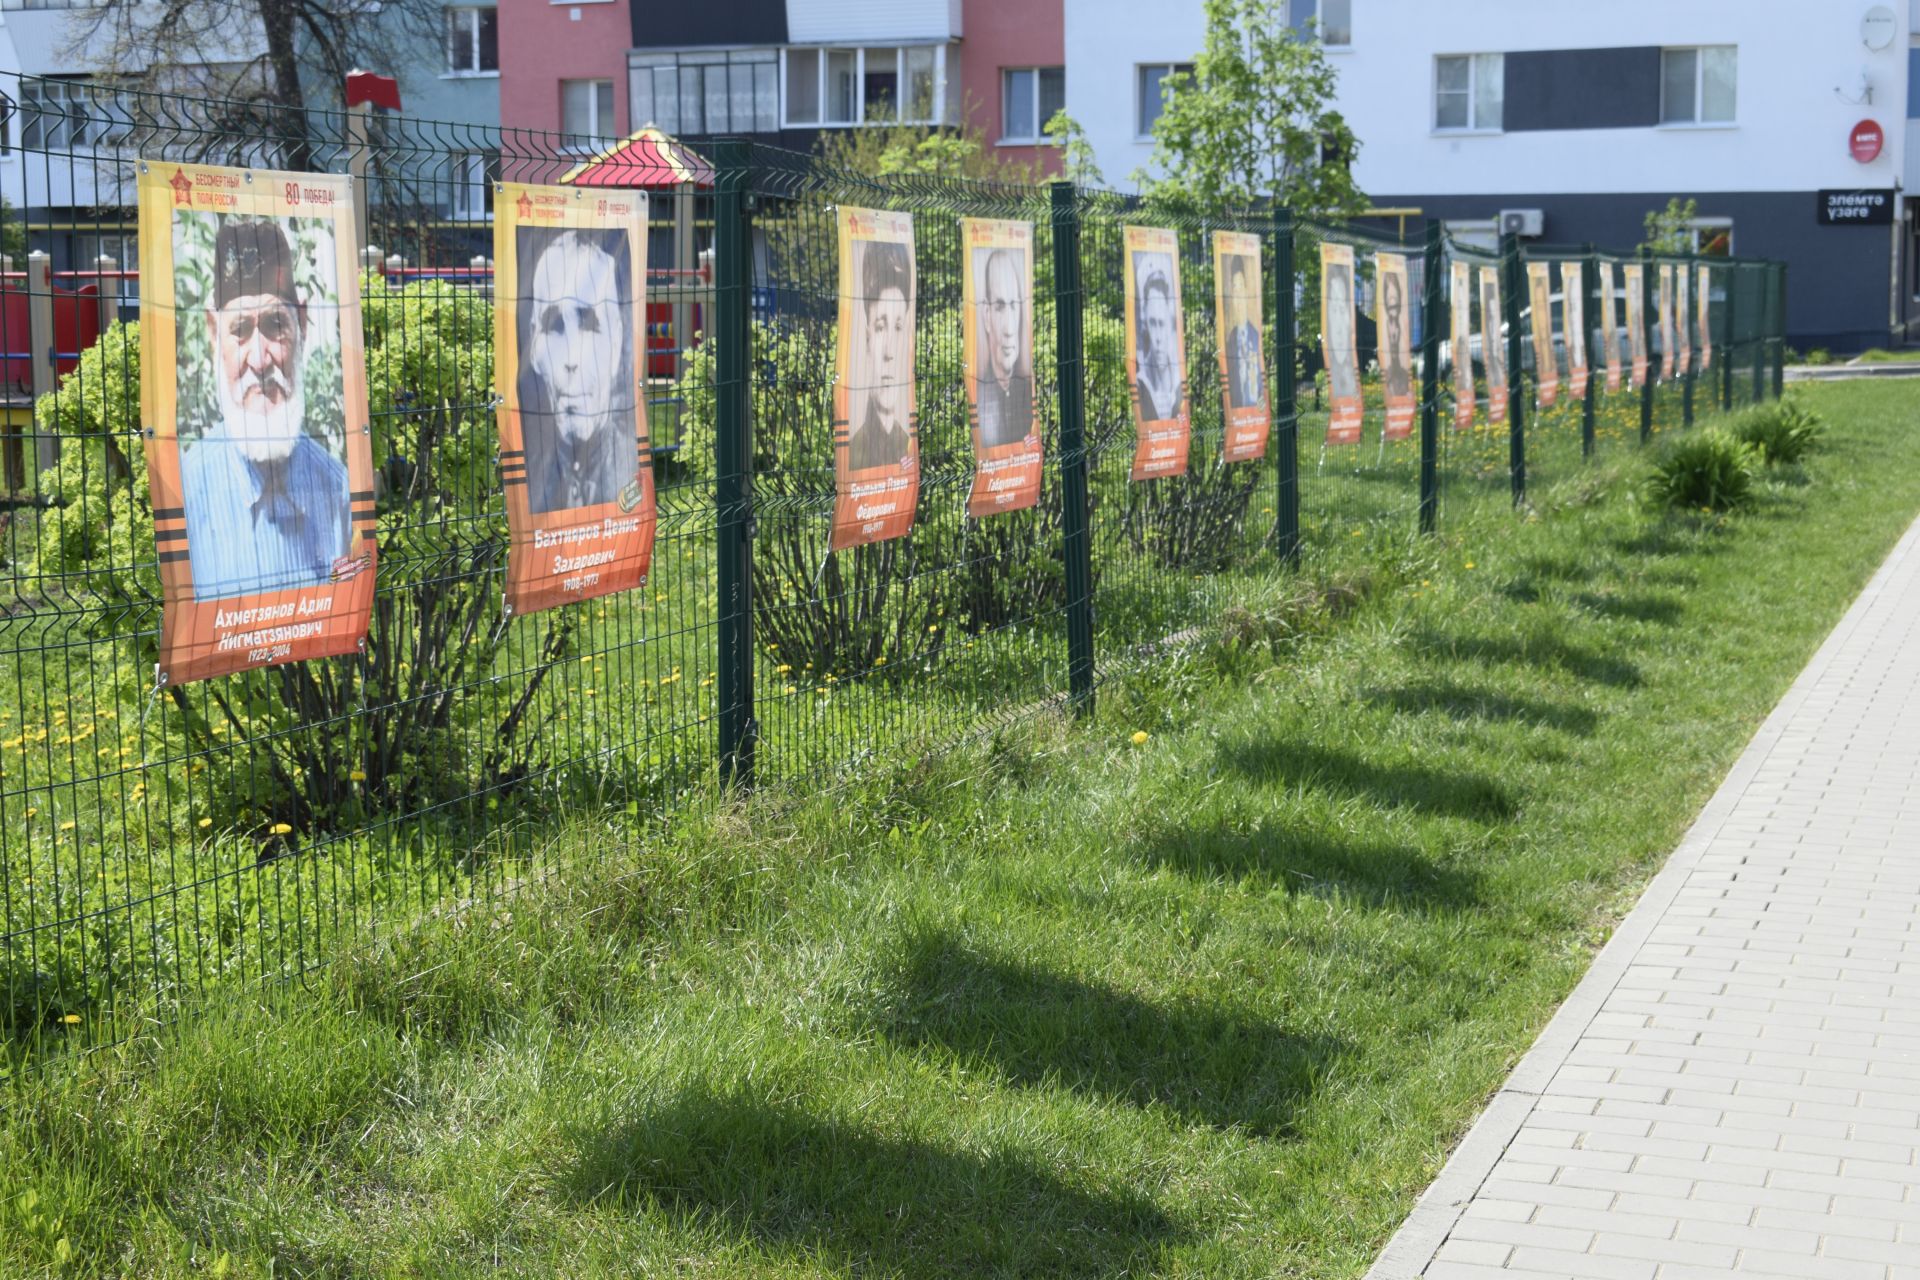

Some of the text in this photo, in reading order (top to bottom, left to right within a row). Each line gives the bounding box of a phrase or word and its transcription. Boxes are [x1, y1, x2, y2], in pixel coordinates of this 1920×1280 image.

[195, 173, 240, 188] БЕССМЕРТНЫЙ
[285, 182, 335, 205] 80 ПОБЕДА!
[534, 517, 640, 549] Бахтияров Денис
[553, 548, 616, 575] Захарович
[563, 573, 600, 592] 1908-1973
[214, 597, 332, 628] Ахметзянов Адип
[218, 621, 323, 651] Нигматзянович
